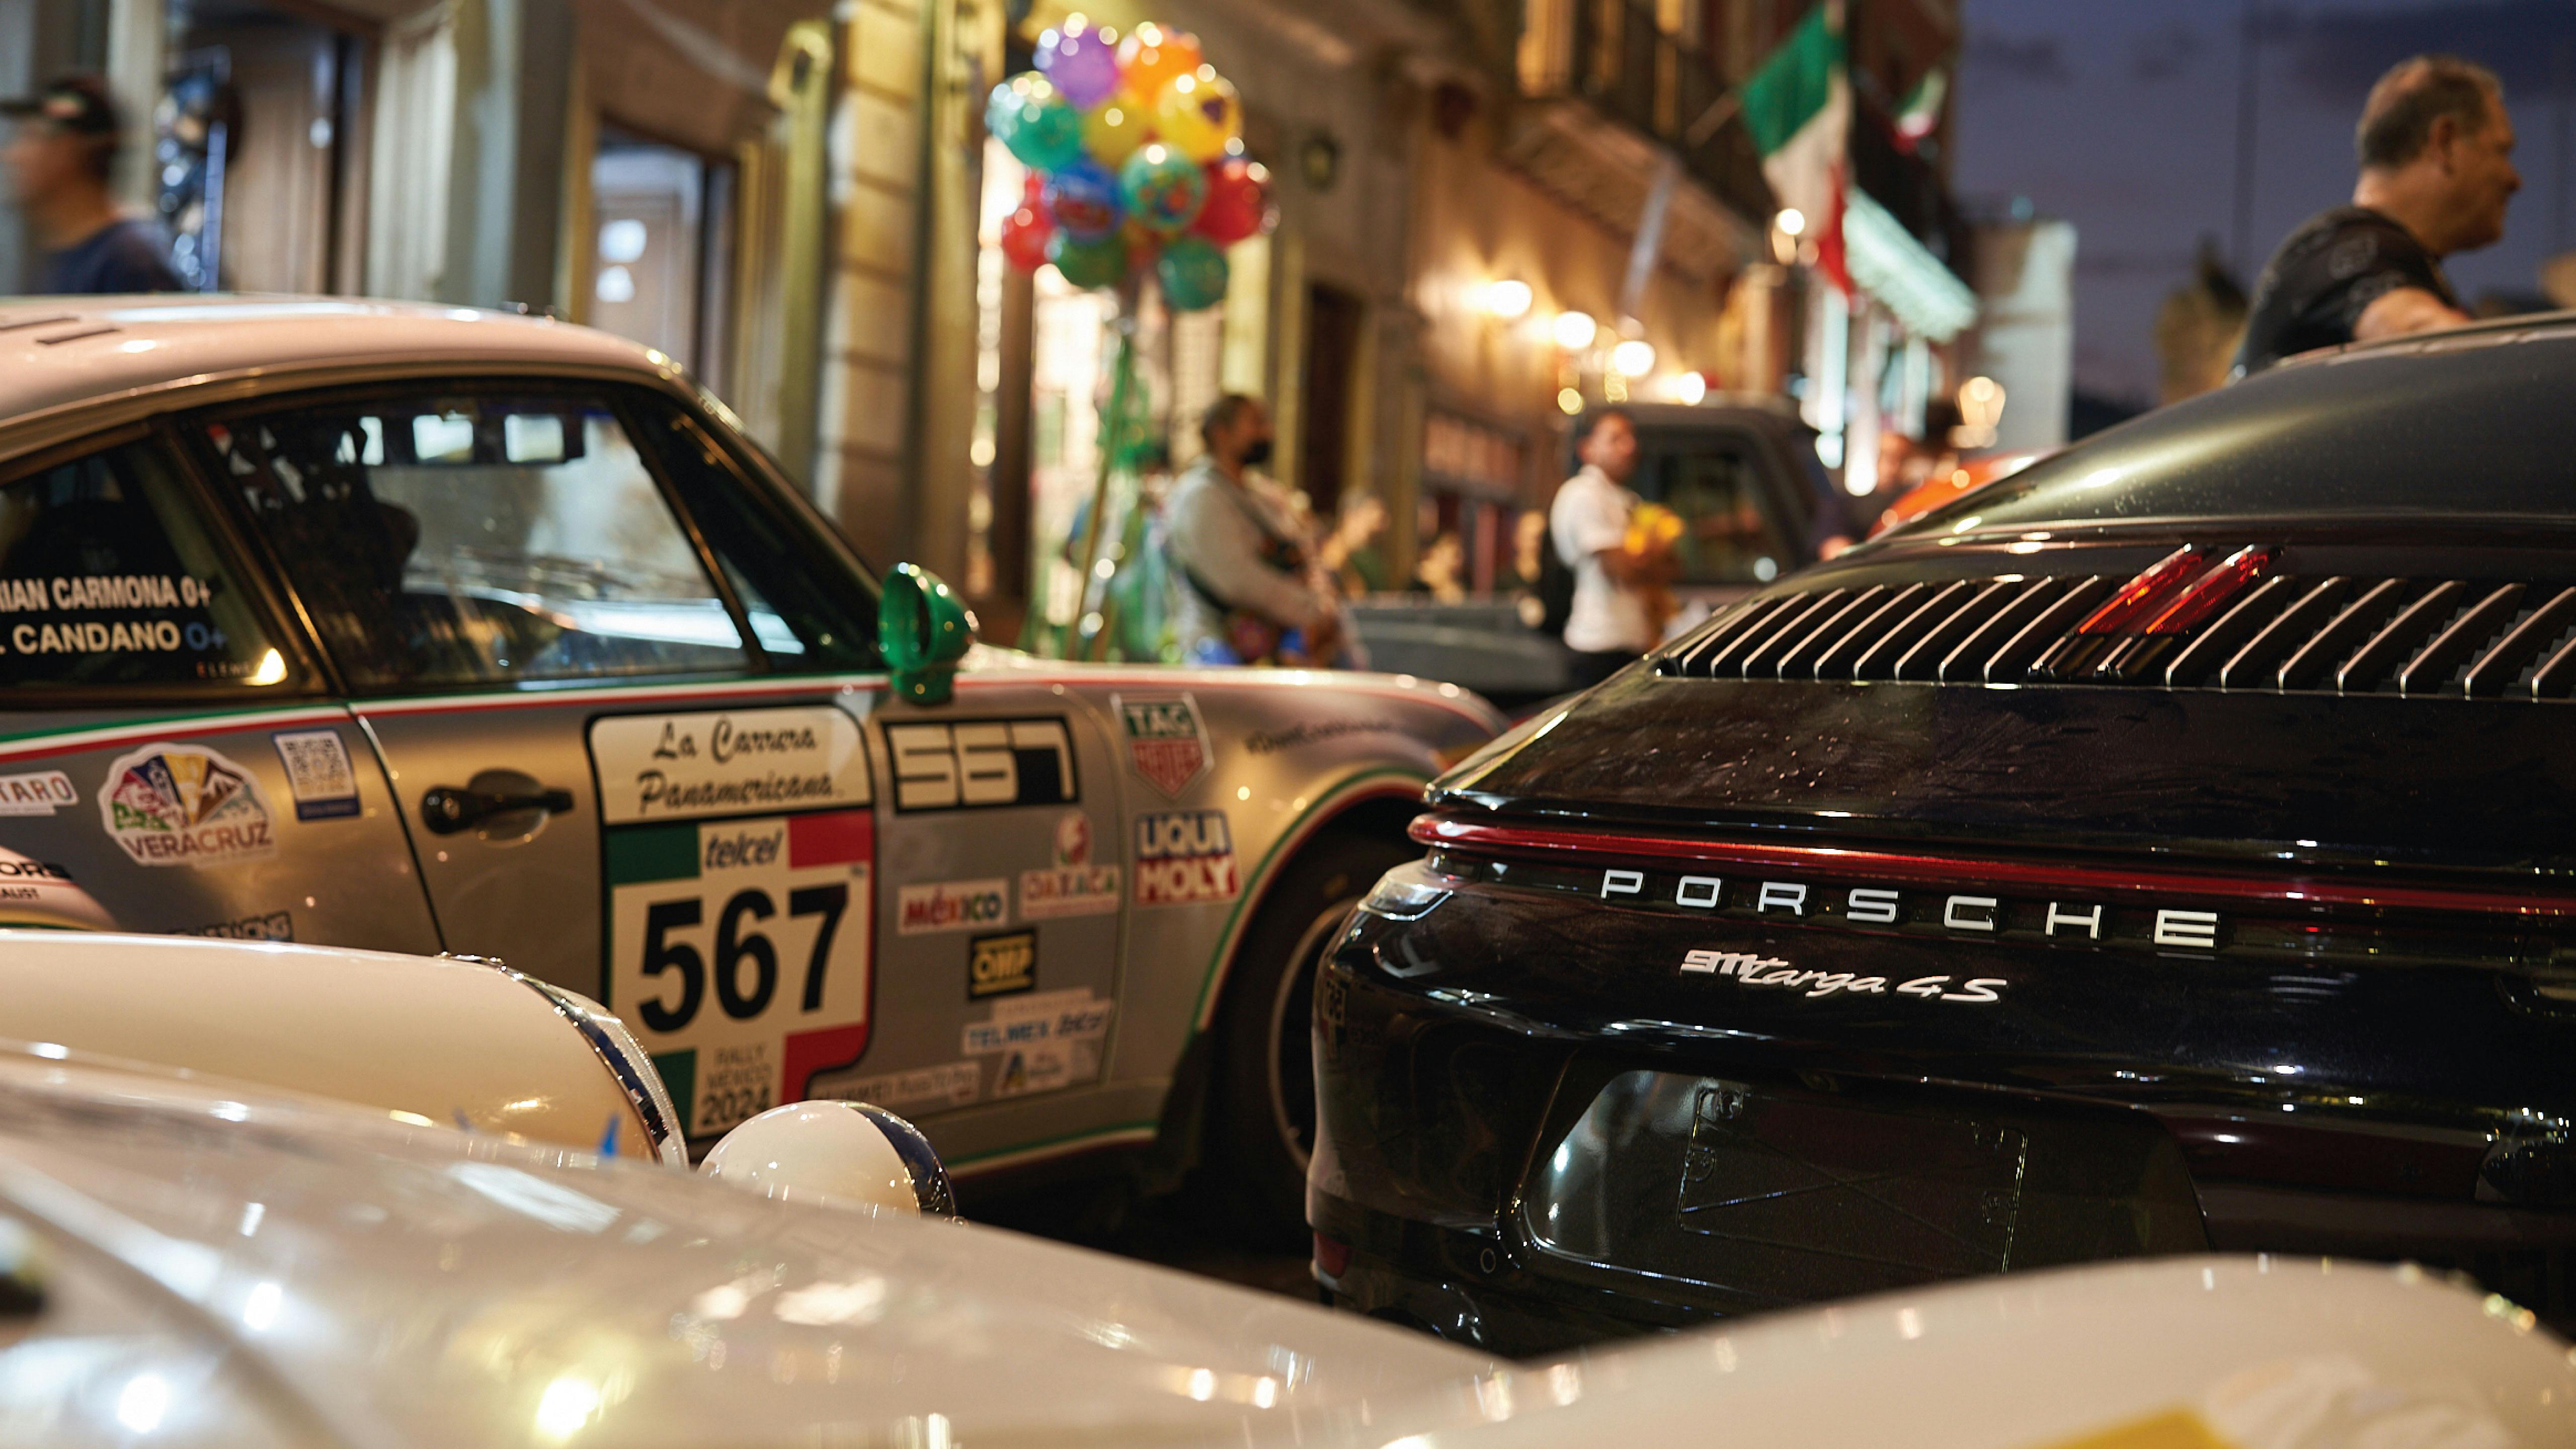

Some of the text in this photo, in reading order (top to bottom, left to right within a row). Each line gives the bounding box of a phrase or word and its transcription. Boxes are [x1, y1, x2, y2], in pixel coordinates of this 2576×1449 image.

[0, 579, 49, 612] IAN
[52, 575, 180, 608] CARMONA
[13, 620, 181, 654] CANDANO
[653, 715, 818, 764] La Carrera
[1126, 705, 1196, 735] TAG
[637, 769, 835, 814] Panamericana
[123, 821, 273, 858] VERACRUZ
[704, 828, 782, 869] telcel
[1138, 815, 1228, 856] LIQUI
[1138, 854, 1234, 902] MOLY
[1601, 868, 2218, 948] PORSCHE
[638, 882, 850, 1033] 567
[973, 946, 1033, 982] OMP
[715, 1042, 768, 1065] RALLY
[702, 1086, 770, 1126] 2024
